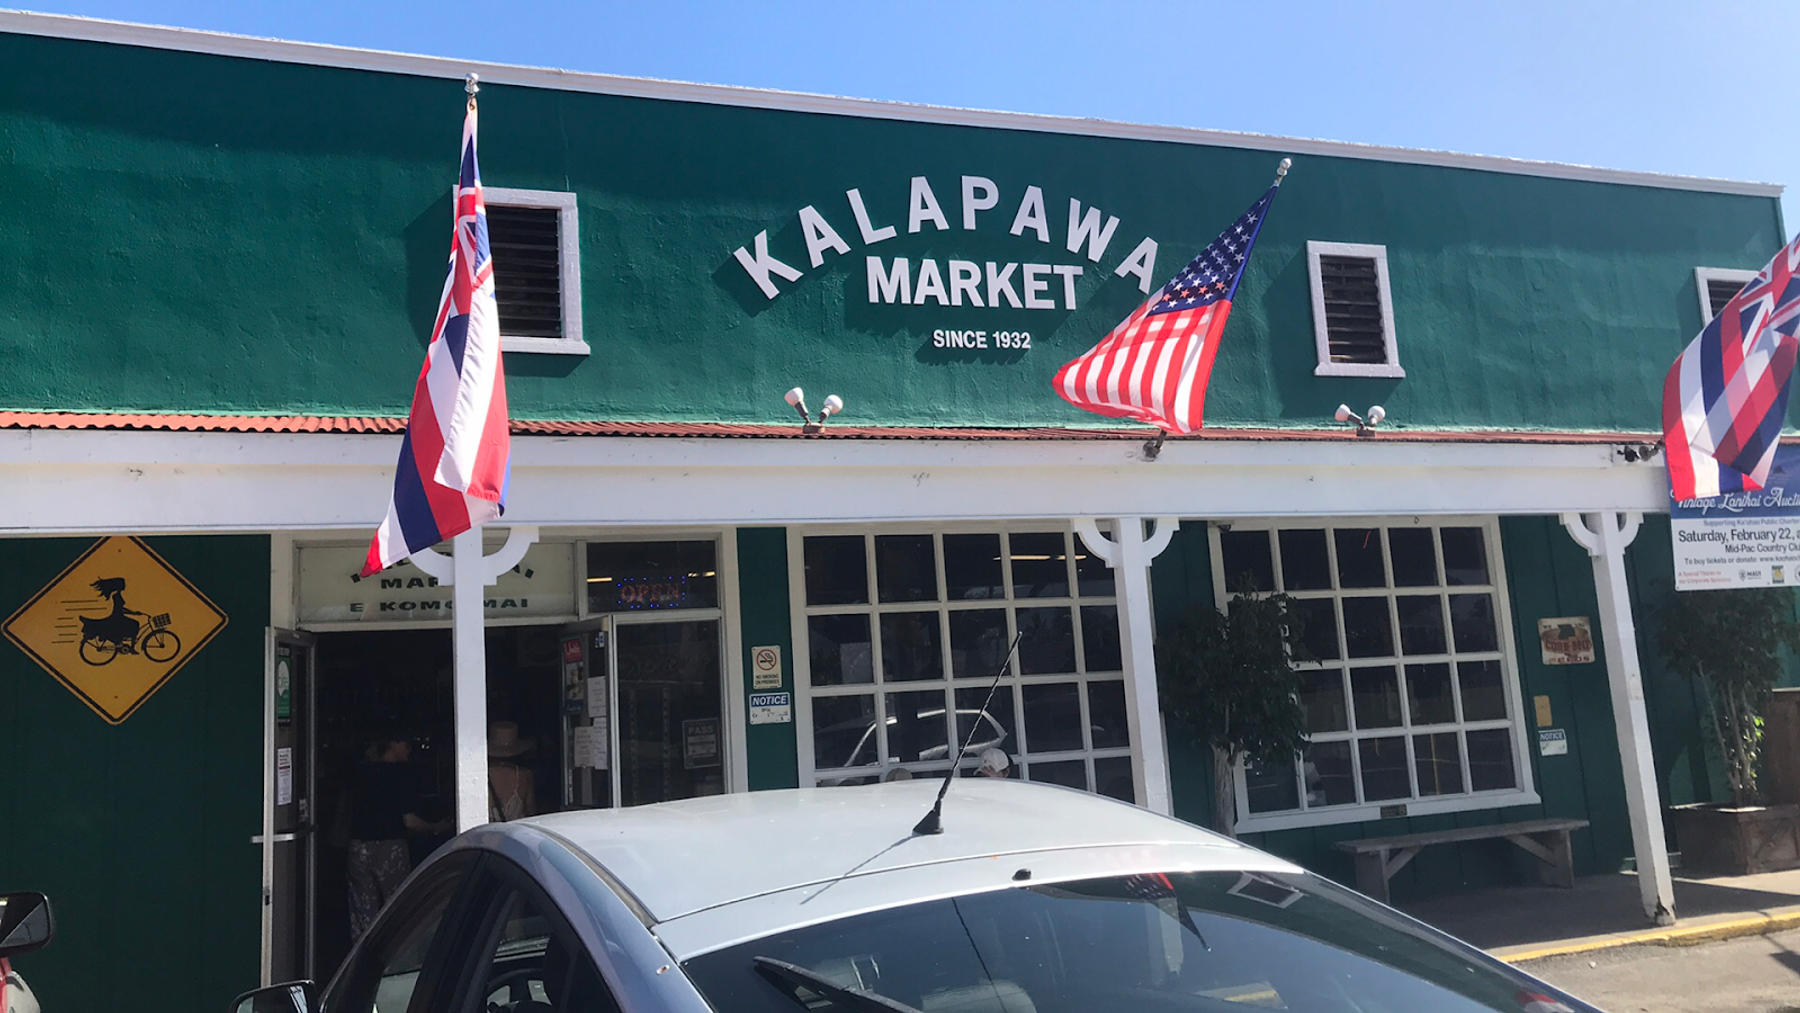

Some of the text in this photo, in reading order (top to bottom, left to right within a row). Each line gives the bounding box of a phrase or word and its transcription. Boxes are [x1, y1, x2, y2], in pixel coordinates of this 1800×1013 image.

[866, 256, 1084, 311] MARKET
[932, 329, 1032, 350] SINCE 1932
[1718, 491, 1761, 513] Lanikai
[1678, 529, 1729, 544] Saturday,
[1731, 528, 1777, 543] February
[1778, 527, 1795, 540] 22,
[1725, 544, 1755, 553] Mid-Pac
[1756, 543, 1787, 554] Country
[1693, 557, 1705, 566] buy
[380, 577, 439, 589] MAR
[621, 582, 681, 603] OPEN
[350, 603, 364, 612] E
[752, 695, 787, 705] NOTICE
[688, 724, 714, 735] PASS
[1539, 732, 1562, 740] NOTICE
